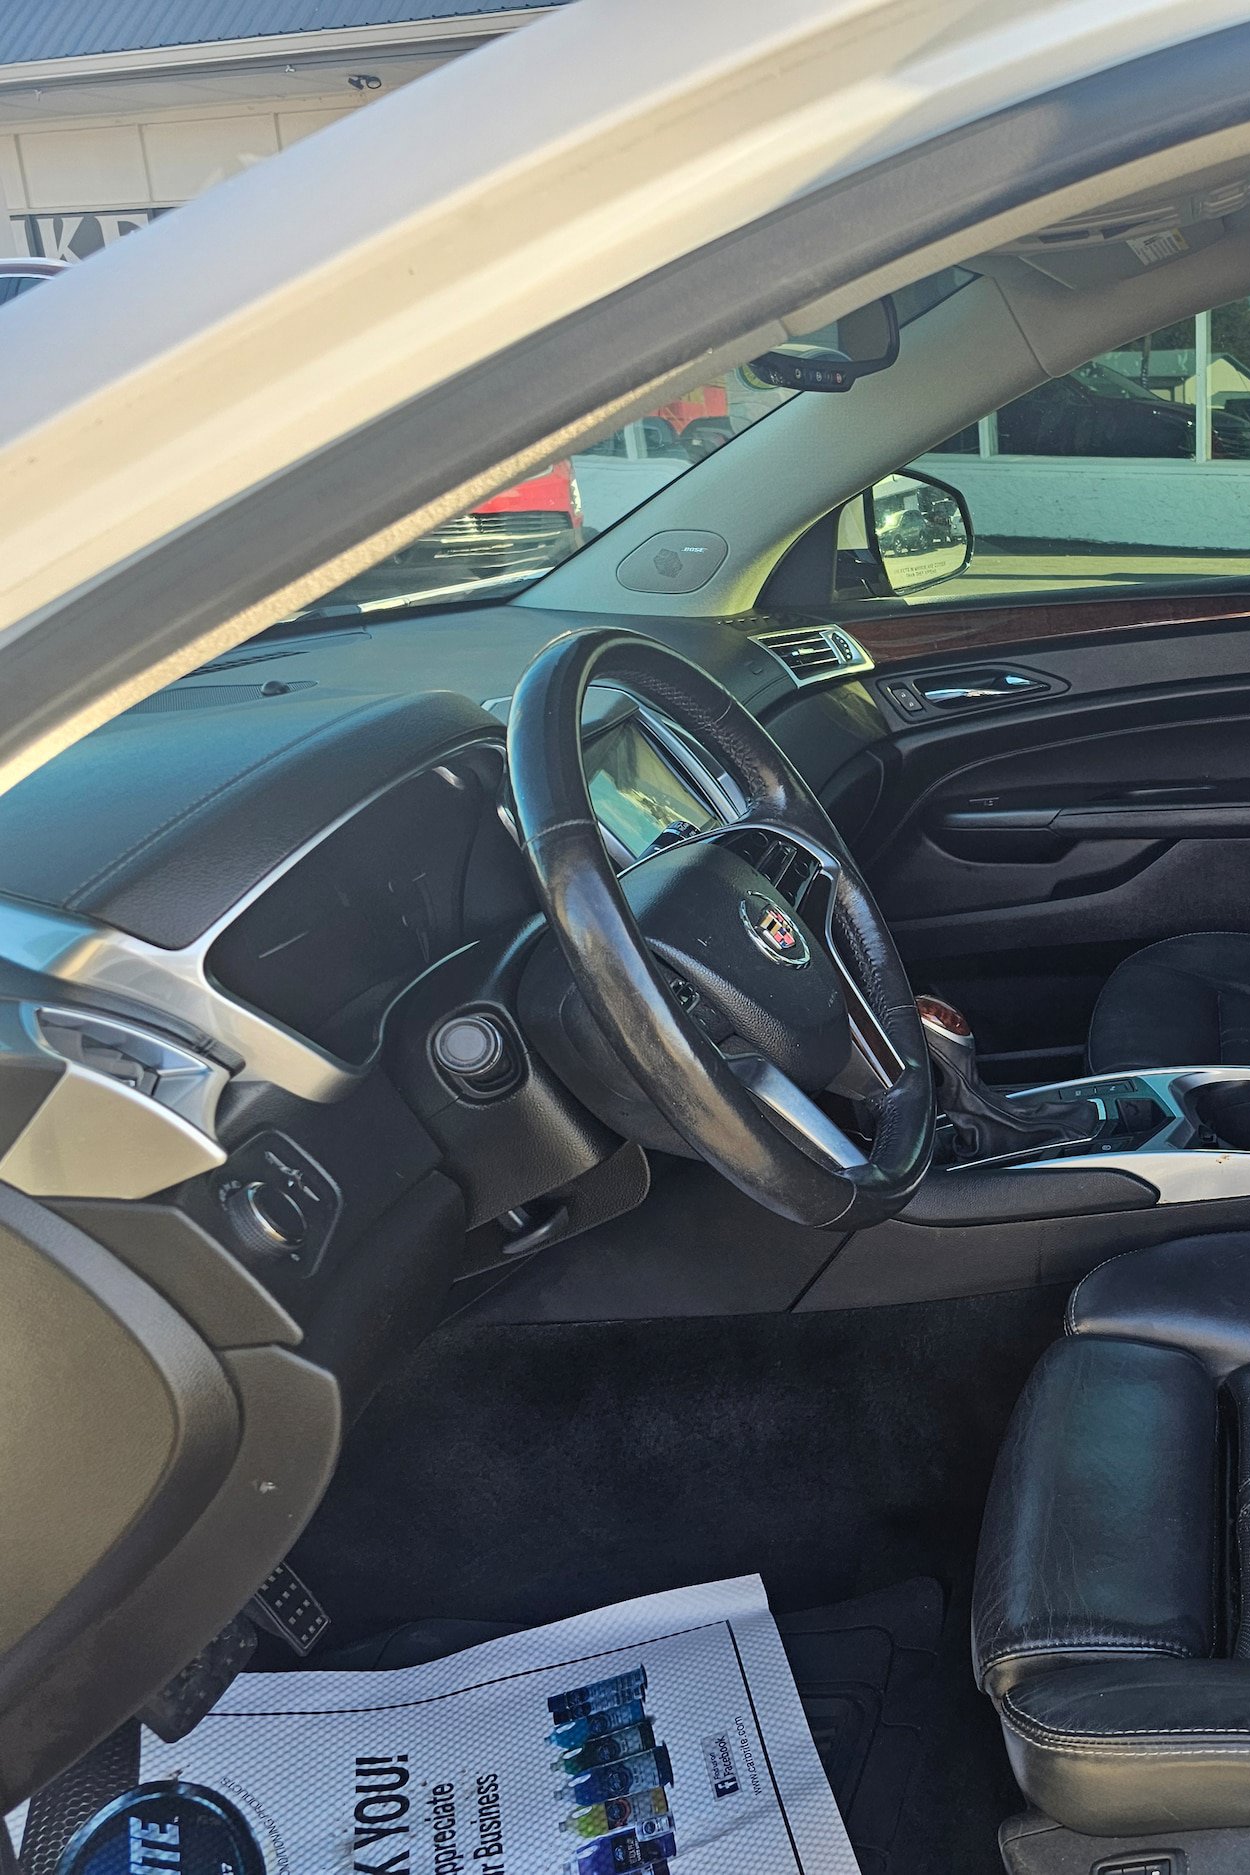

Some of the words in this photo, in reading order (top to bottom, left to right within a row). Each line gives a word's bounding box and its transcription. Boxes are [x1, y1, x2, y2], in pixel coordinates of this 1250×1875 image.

[714, 1735, 734, 1777] Facebook
[353, 1754, 410, 1850] YOU!
[424, 1782, 464, 1875] ppreciate
[470, 1773, 503, 1859] Business
